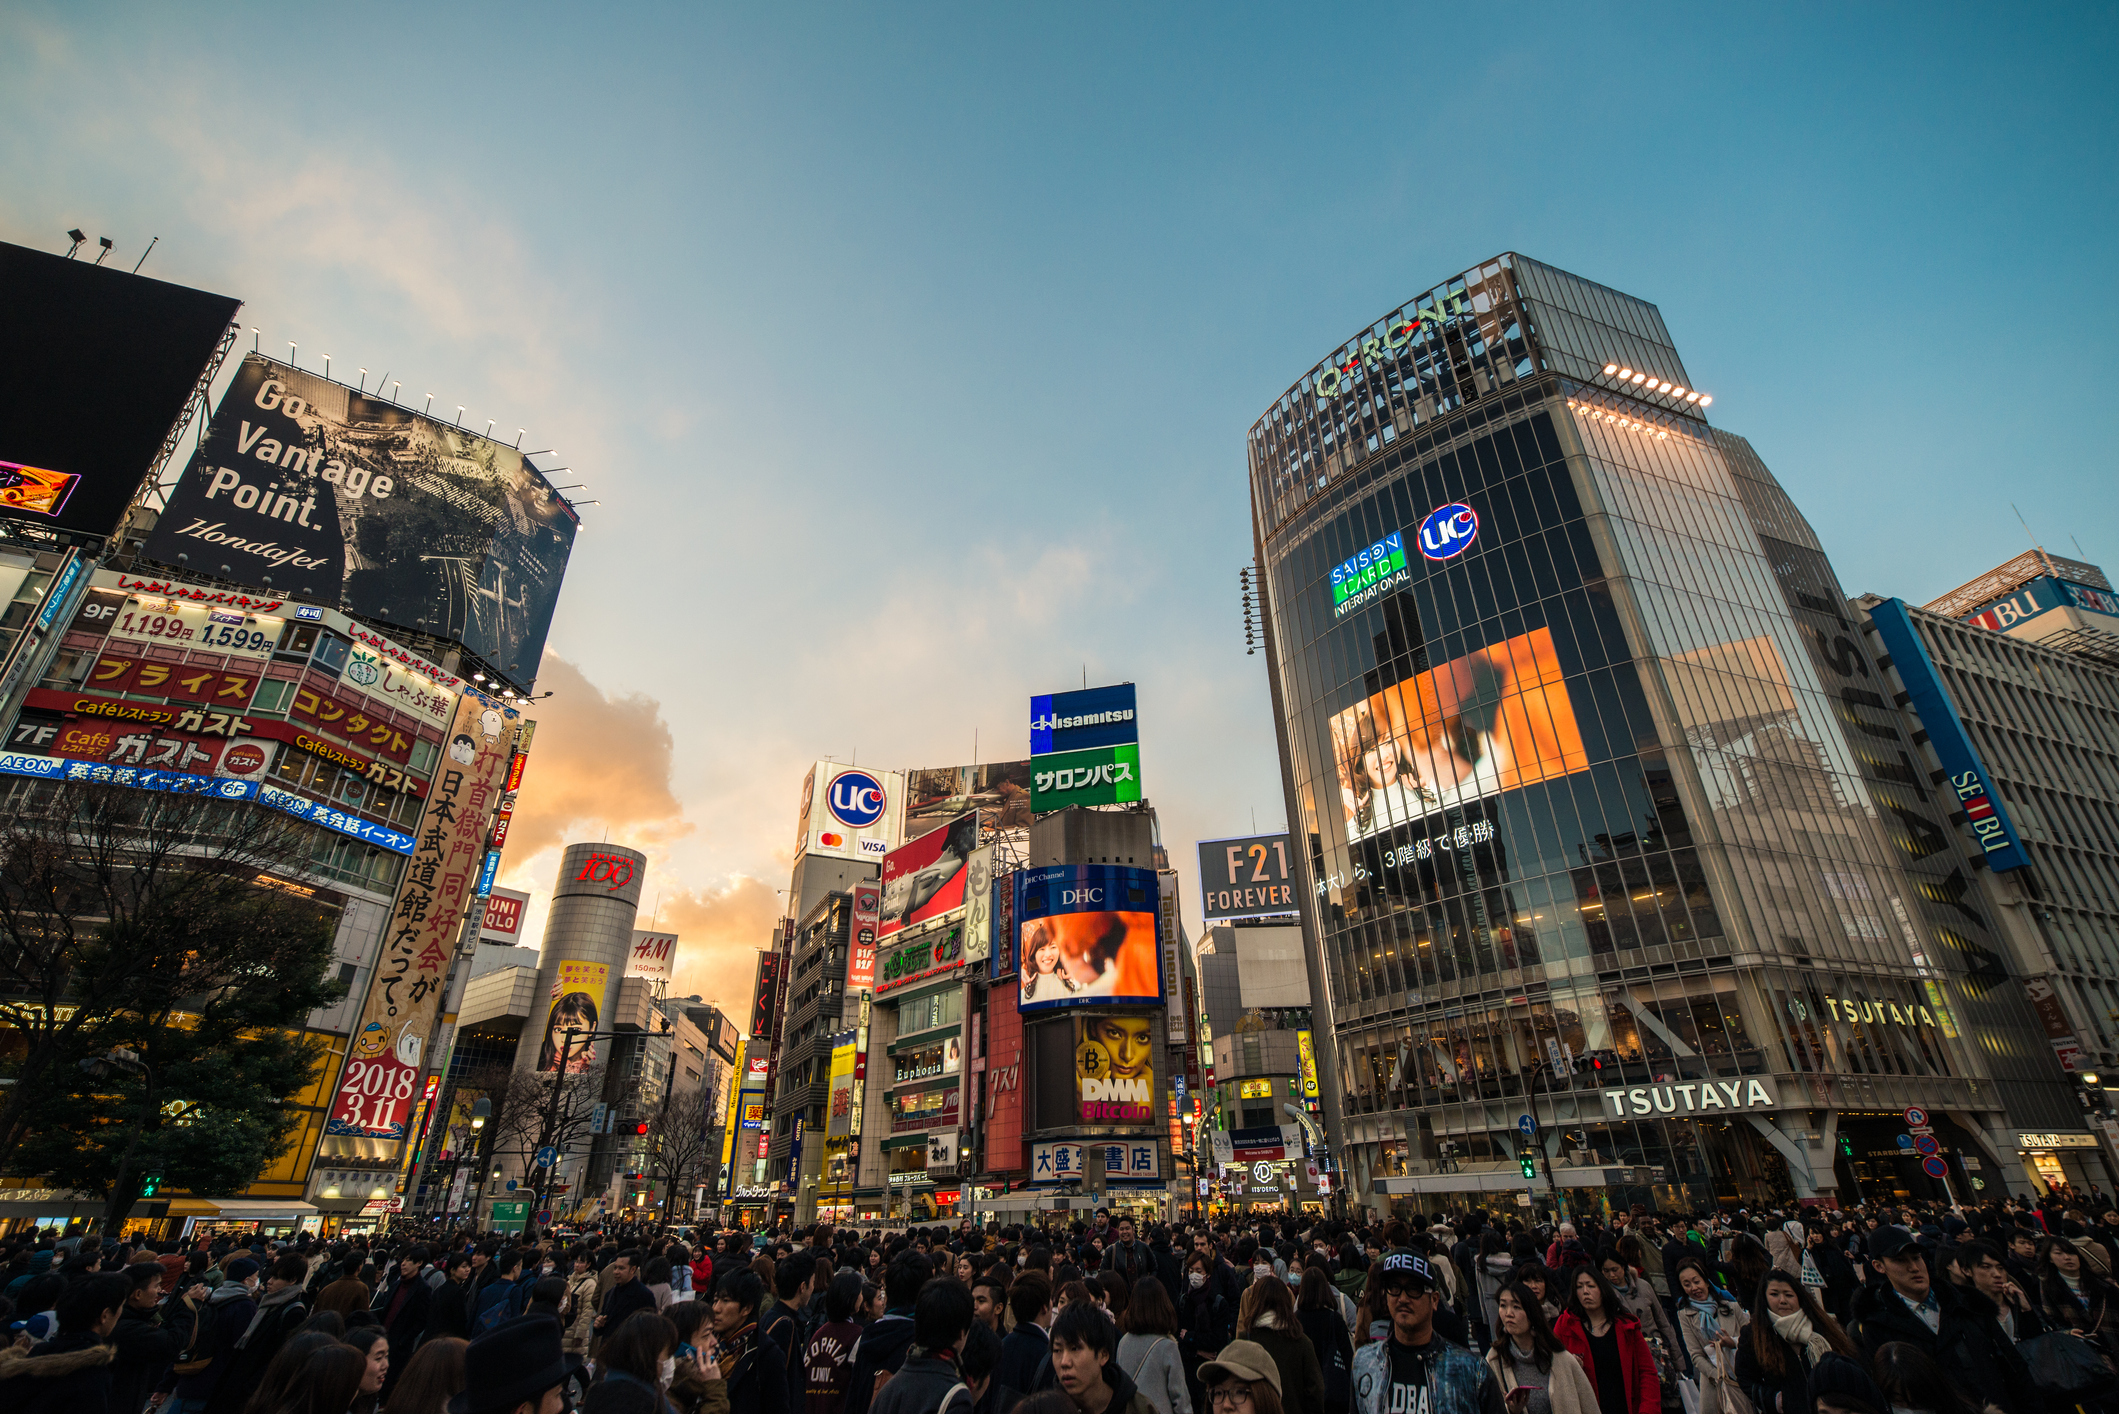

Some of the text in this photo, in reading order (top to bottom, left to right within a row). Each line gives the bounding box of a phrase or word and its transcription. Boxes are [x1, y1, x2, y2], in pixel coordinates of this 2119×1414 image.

[1316, 287, 1466, 398] QFRONT
[255, 378, 307, 419] Go
[236, 421, 394, 500] Vantage
[205, 468, 325, 532] Point.
[175, 517, 333, 572] HondaJet
[1332, 534, 1399, 584] SAISON
[1343, 559, 1391, 594] CARD
[117, 574, 284, 613] しゃぶしゃぶバイキング
[1335, 570, 1410, 618] INTERNATONAL
[82, 604, 117, 622] 9F
[118, 612, 195, 641] 1,199円
[212, 611, 242, 623] ディナー
[298, 607, 321, 619] 寿司
[202, 623, 275, 652] 1,599円
[348, 622, 460, 687] しゃぶしゃぶバイキング
[95, 659, 250, 699] プライス
[382, 671, 450, 717] しゃぶ葉
[16, 723, 58, 745] 7F
[173, 709, 252, 737] ガスト
[293, 688, 409, 753] コンタクト
[1030, 707, 1134, 731] Hisamitsu
[64, 729, 111, 748] Café
[108, 734, 212, 770] ガスト
[1, 755, 53, 773] AEON
[228, 754, 261, 768] ガスト
[1034, 761, 1134, 792] サロンパス
[365, 762, 418, 795] ガスト
[833, 782, 883, 815] UC
[1951, 770, 2010, 855] SEIBU
[312, 805, 414, 850] 英会話イーオン
[495, 819, 508, 843] ガスト
[860, 840, 887, 854] VISA
[1225, 840, 1289, 885] F21
[409, 743, 504, 1004] 打首獄門同好会が
[575, 858, 634, 892] 109
[1025, 870, 1065, 885] DHC Channel
[379, 769, 464, 1018] 日本武道館だって。
[489, 898, 516, 915] UNI
[967, 858, 989, 956] もんじゃ
[1061, 887, 1104, 905] DHC
[1206, 884, 1293, 912] FOREVER
[465, 907, 483, 951] 渋谷駅前ビル
[486, 912, 514, 929] QLO
[632, 936, 673, 962] H&M
[1161, 890, 1178, 997] Taisei neon
[634, 963, 657, 973] 150m
[770, 953, 779, 978] TOKYO
[1078, 997, 1092, 1005] DHC
[1826, 997, 1936, 1028] TSUTAYA
[2052, 1039, 2078, 1047] TSUTAYA
[341, 1060, 416, 1100] 2018
[896, 1062, 942, 1082] Euphoria
[832, 1086, 850, 1117] 薬
[943, 1091, 959, 1111] JTB
[1081, 1077, 1150, 1102] DMM
[1605, 1079, 1774, 1116] TSUTAYA
[341, 1092, 397, 1131] 3.11
[1081, 1102, 1151, 1119] Bitcoin
[2018, 1133, 2062, 1147] TSUTAYA
[736, 1184, 770, 1198] グルメタウン
[804, 1336, 848, 1368] SOPHIA
